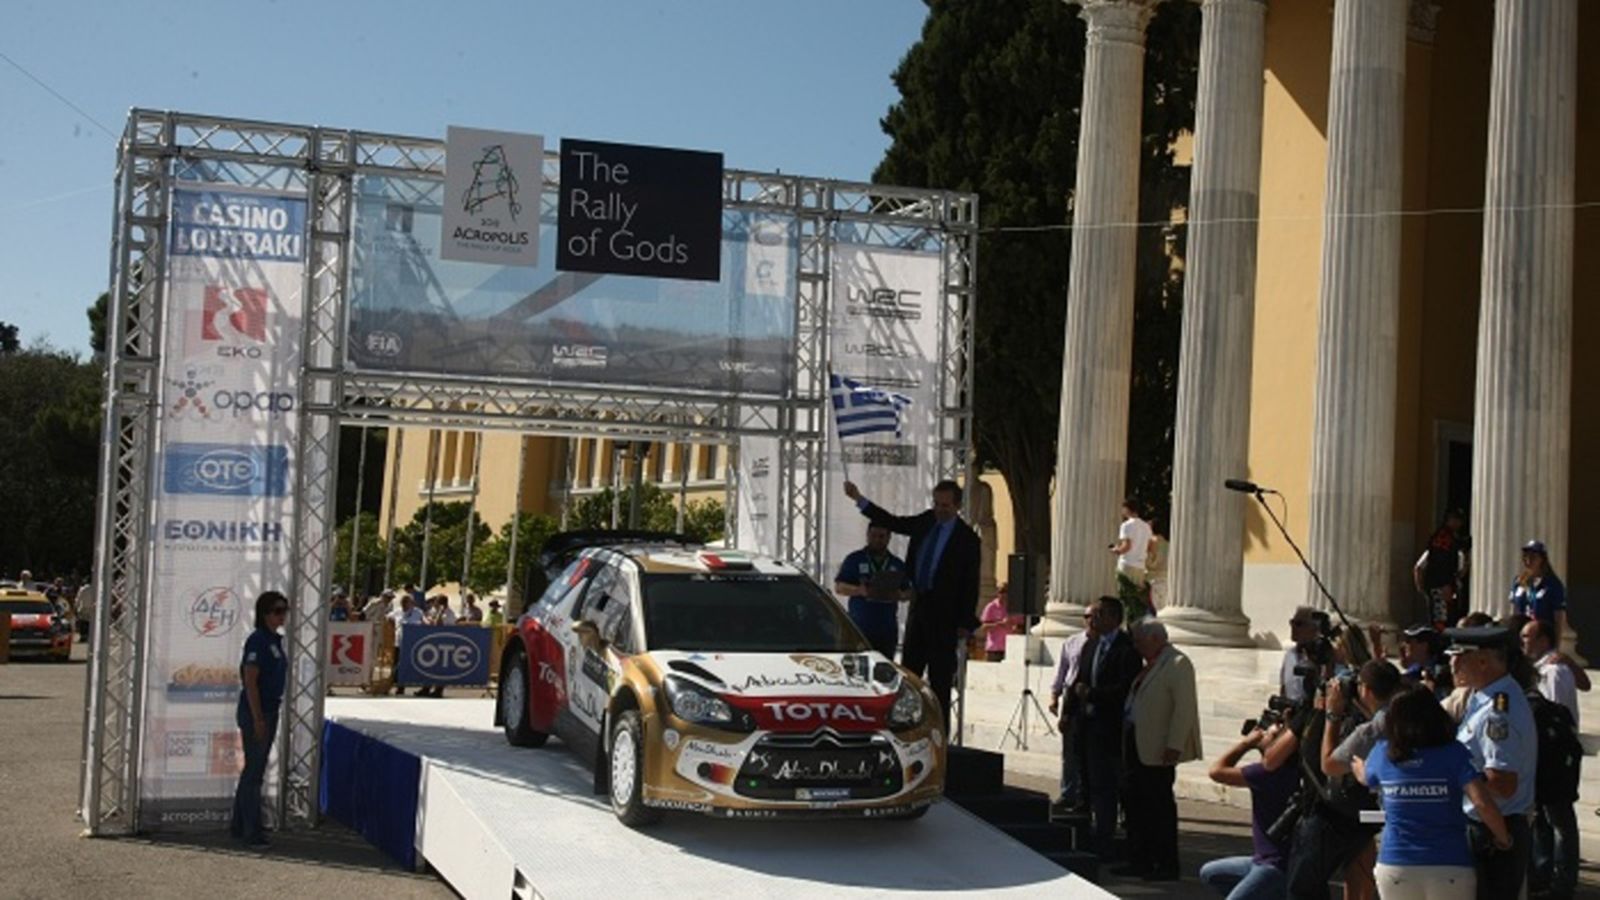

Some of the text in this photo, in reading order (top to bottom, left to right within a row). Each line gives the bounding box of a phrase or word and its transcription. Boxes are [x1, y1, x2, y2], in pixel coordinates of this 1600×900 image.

[571, 150, 629, 184] The
[194, 204, 288, 230] CASINO
[570, 188, 638, 231] Rally
[177, 229, 300, 257] LOUTRAKI
[453, 226, 529, 245] ACROPOLIS
[568, 228, 689, 264] of Gods
[847, 286, 922, 308] WRC
[217, 346, 261, 358] EKO
[368, 334, 401, 354] FIA
[552, 344, 608, 359] WRC
[213, 390, 295, 419] opap
[200, 459, 253, 480] OTE
[164, 520, 282, 542] ΕΘΝΙΚΗ
[417, 643, 473, 668] OTE
[338, 666, 362, 674] EKO
[763, 701, 876, 721] TOTAL
